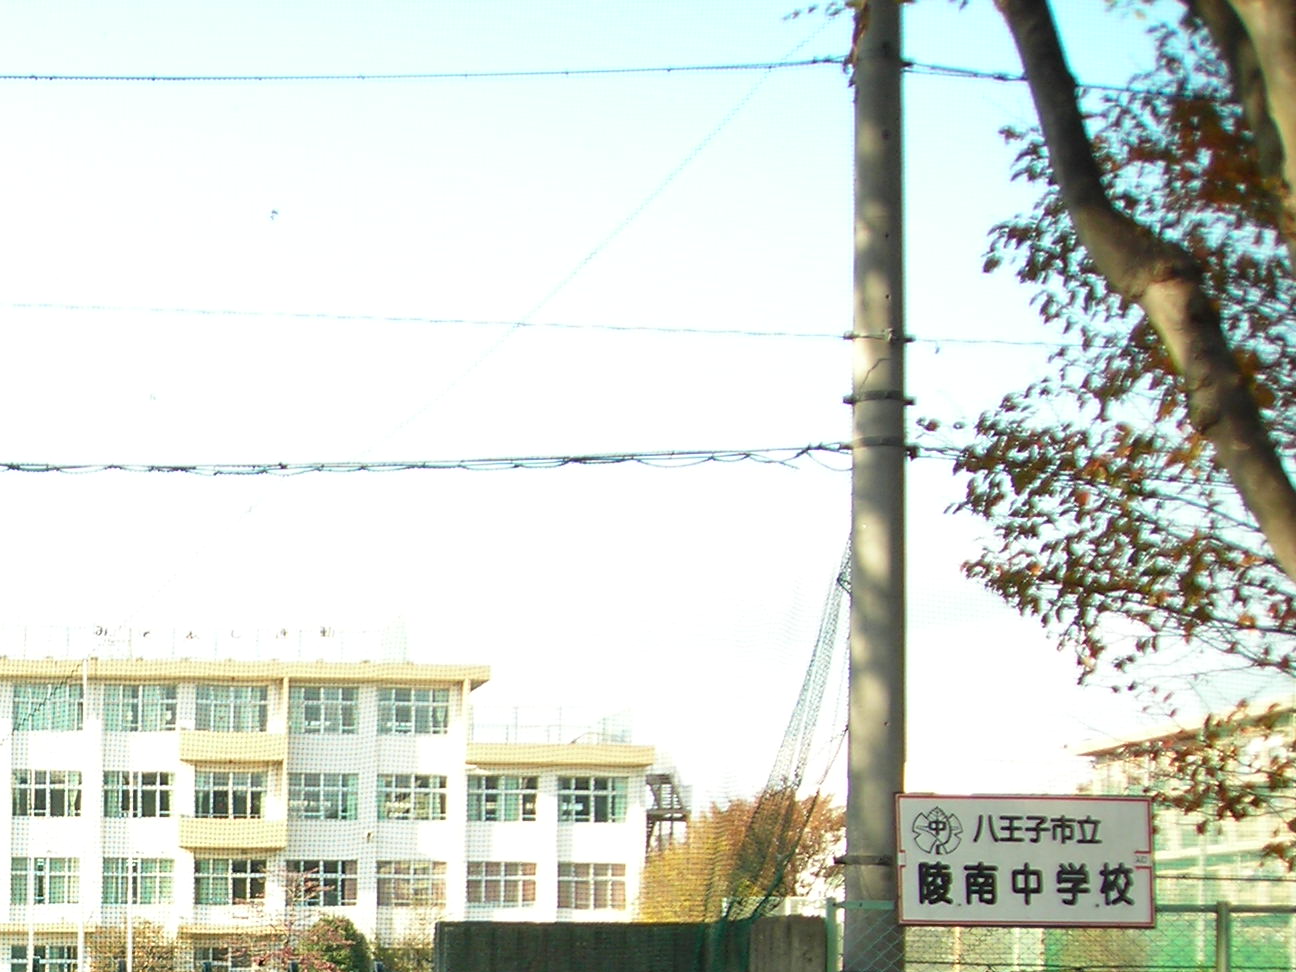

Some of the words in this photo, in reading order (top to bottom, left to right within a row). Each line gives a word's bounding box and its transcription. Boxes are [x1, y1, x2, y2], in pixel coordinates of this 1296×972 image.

[972, 813, 1103, 845] 八王子市立
[917, 861, 1135, 906] 陵南中学校
